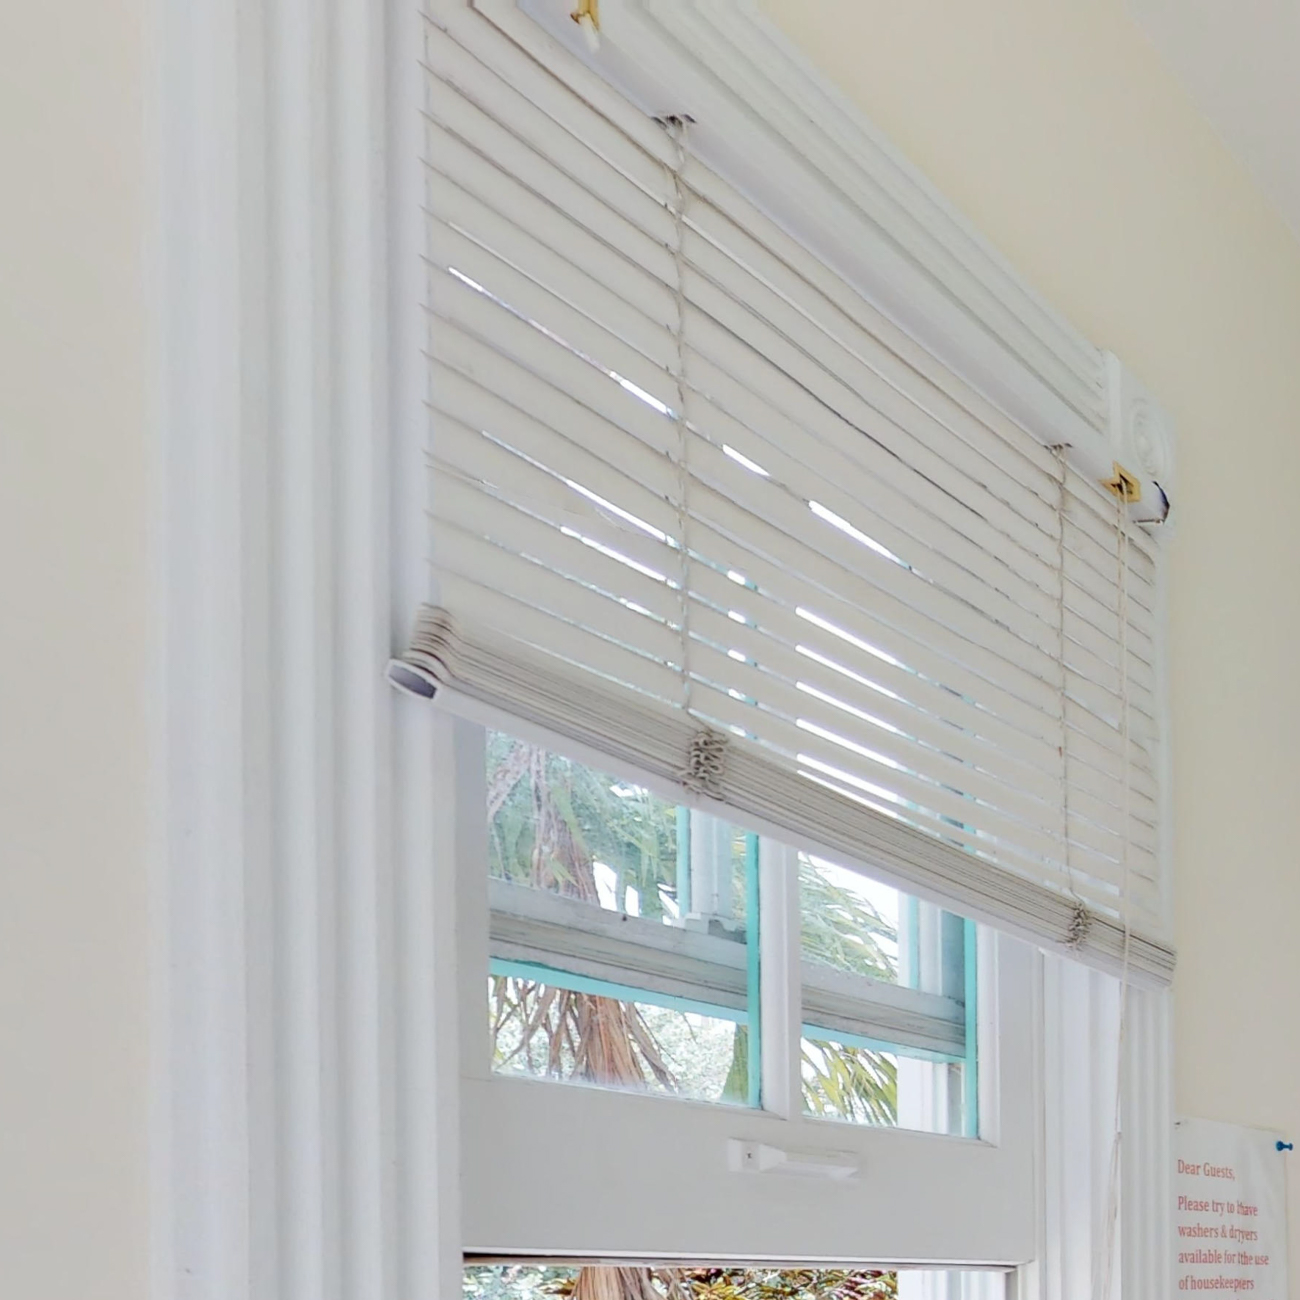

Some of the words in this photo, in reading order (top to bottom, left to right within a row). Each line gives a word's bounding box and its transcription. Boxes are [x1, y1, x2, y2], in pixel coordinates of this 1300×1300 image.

[1177, 1159, 1201, 1175] Dear
[1203, 1162, 1235, 1181] Guests,
[1177, 1195, 1209, 1211] Please
[1212, 1200, 1225, 1217] try
[1227, 1201, 1235, 1213] to
[1178, 1222, 1219, 1238] washers
[1220, 1224, 1227, 1238] &
[1178, 1249, 1222, 1264] available
[1224, 1250, 1236, 1264] for
[1254, 1255, 1270, 1265] use
[1178, 1275, 1189, 1290] of
